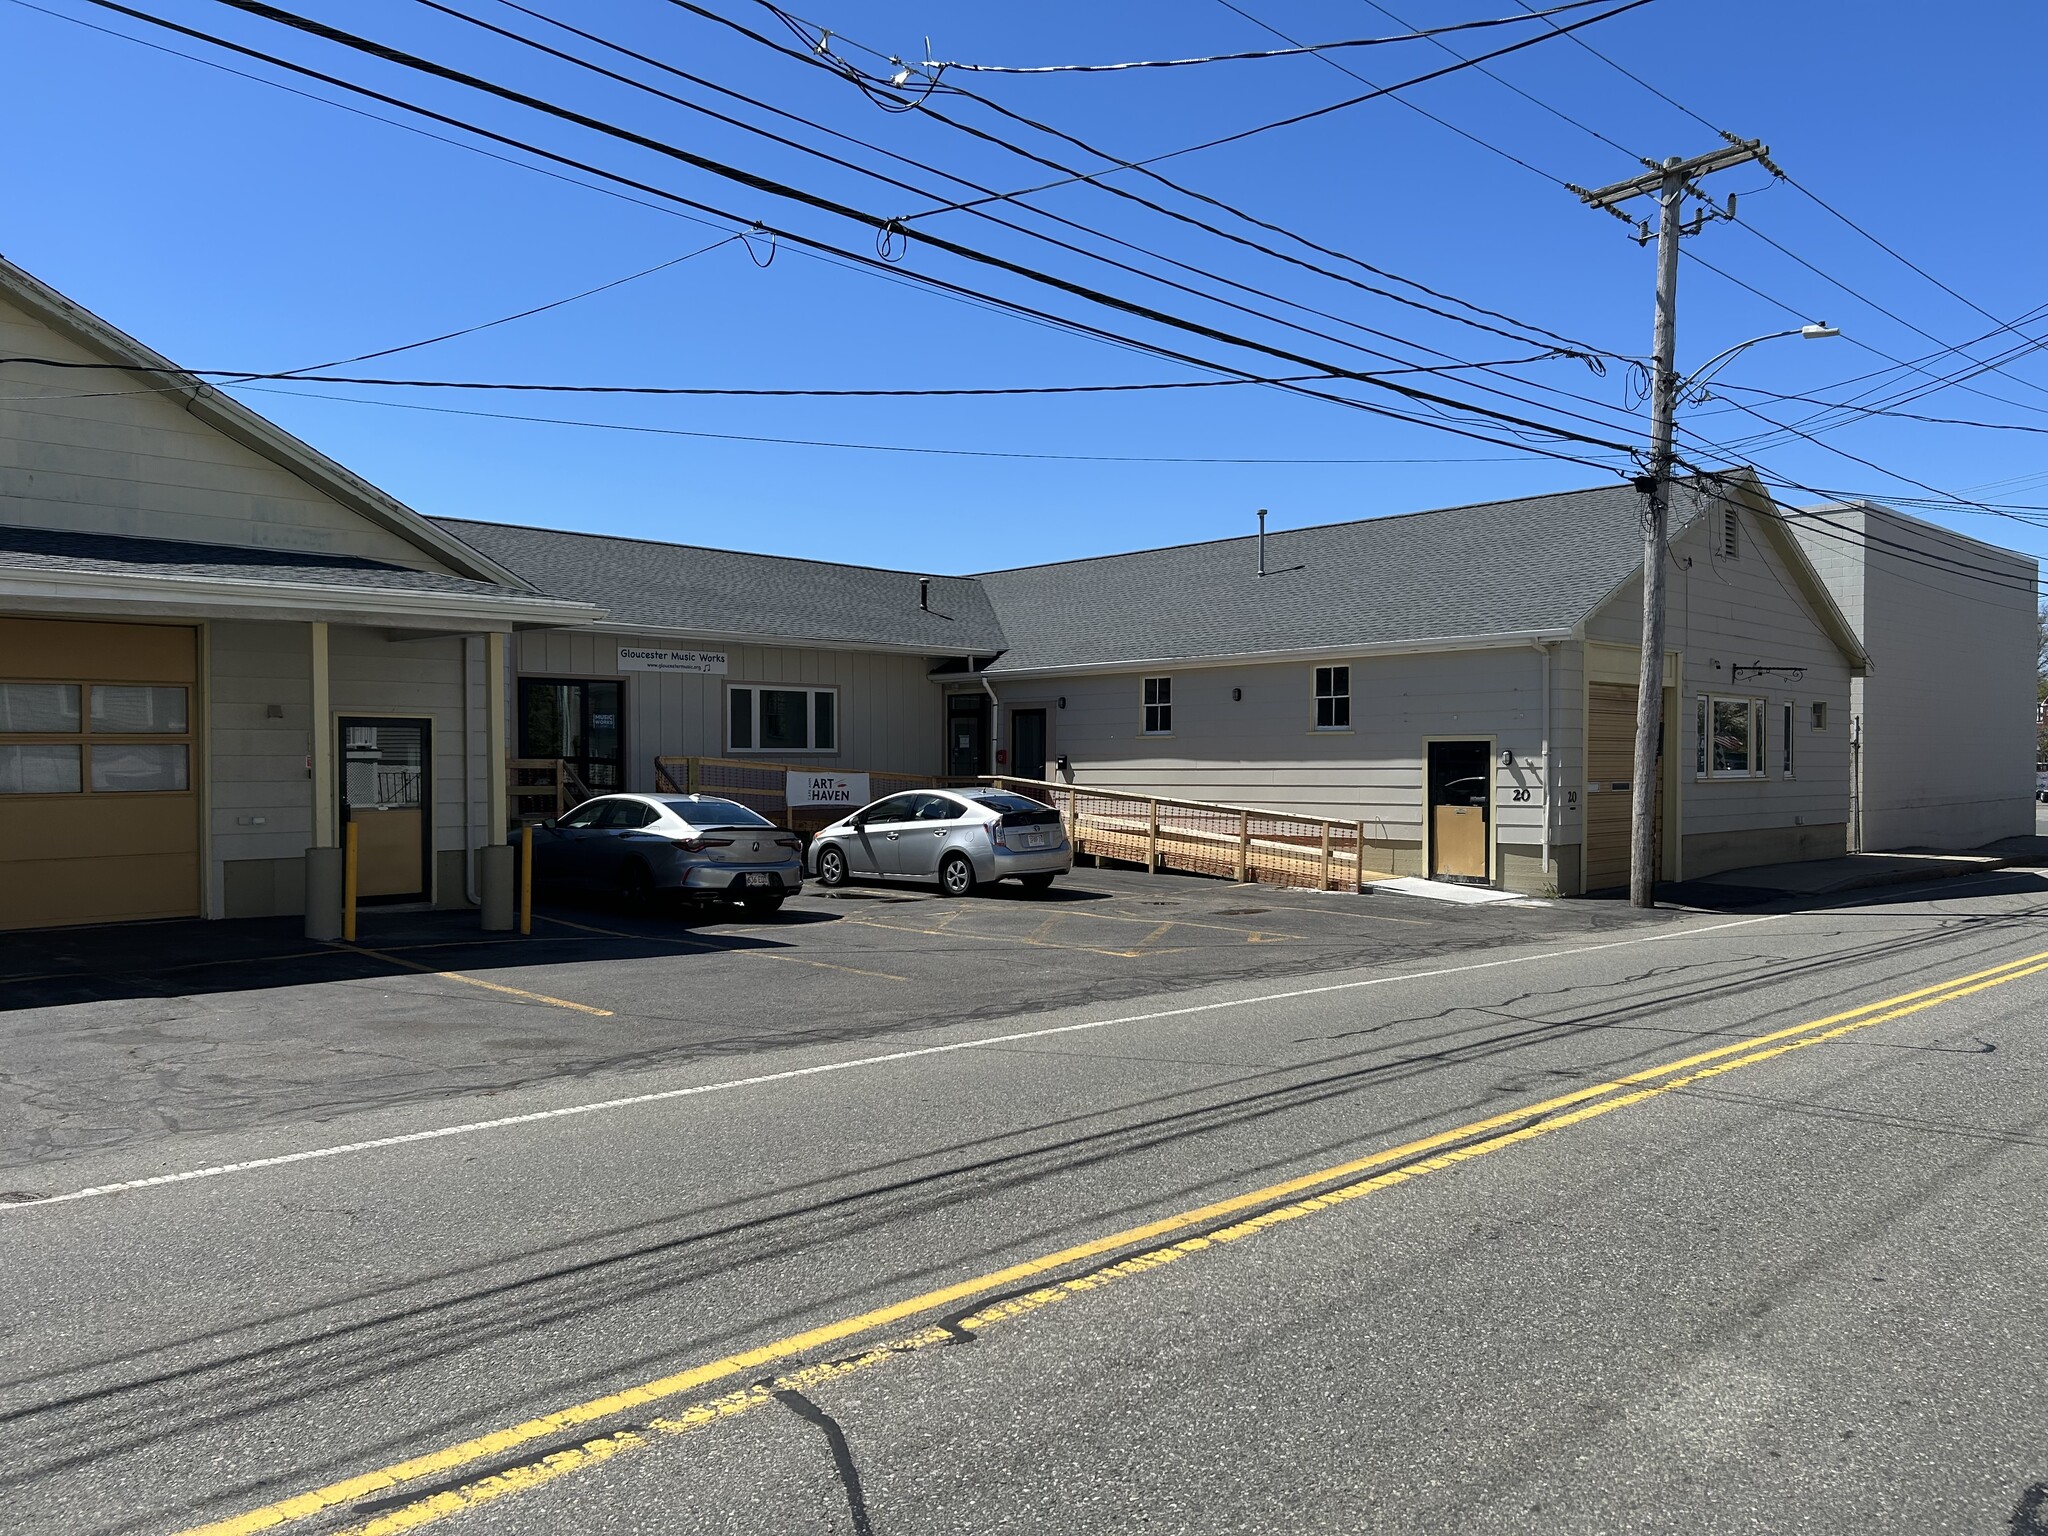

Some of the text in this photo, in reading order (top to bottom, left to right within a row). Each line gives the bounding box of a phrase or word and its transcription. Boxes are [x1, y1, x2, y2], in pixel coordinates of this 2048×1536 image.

[620, 649, 725, 663] Gloucester Music Works
[813, 778, 834, 789] ART
[812, 790, 850, 801] HAVEN
[1513, 789, 1531, 802] 20
[1568, 791, 1577, 803] 20
